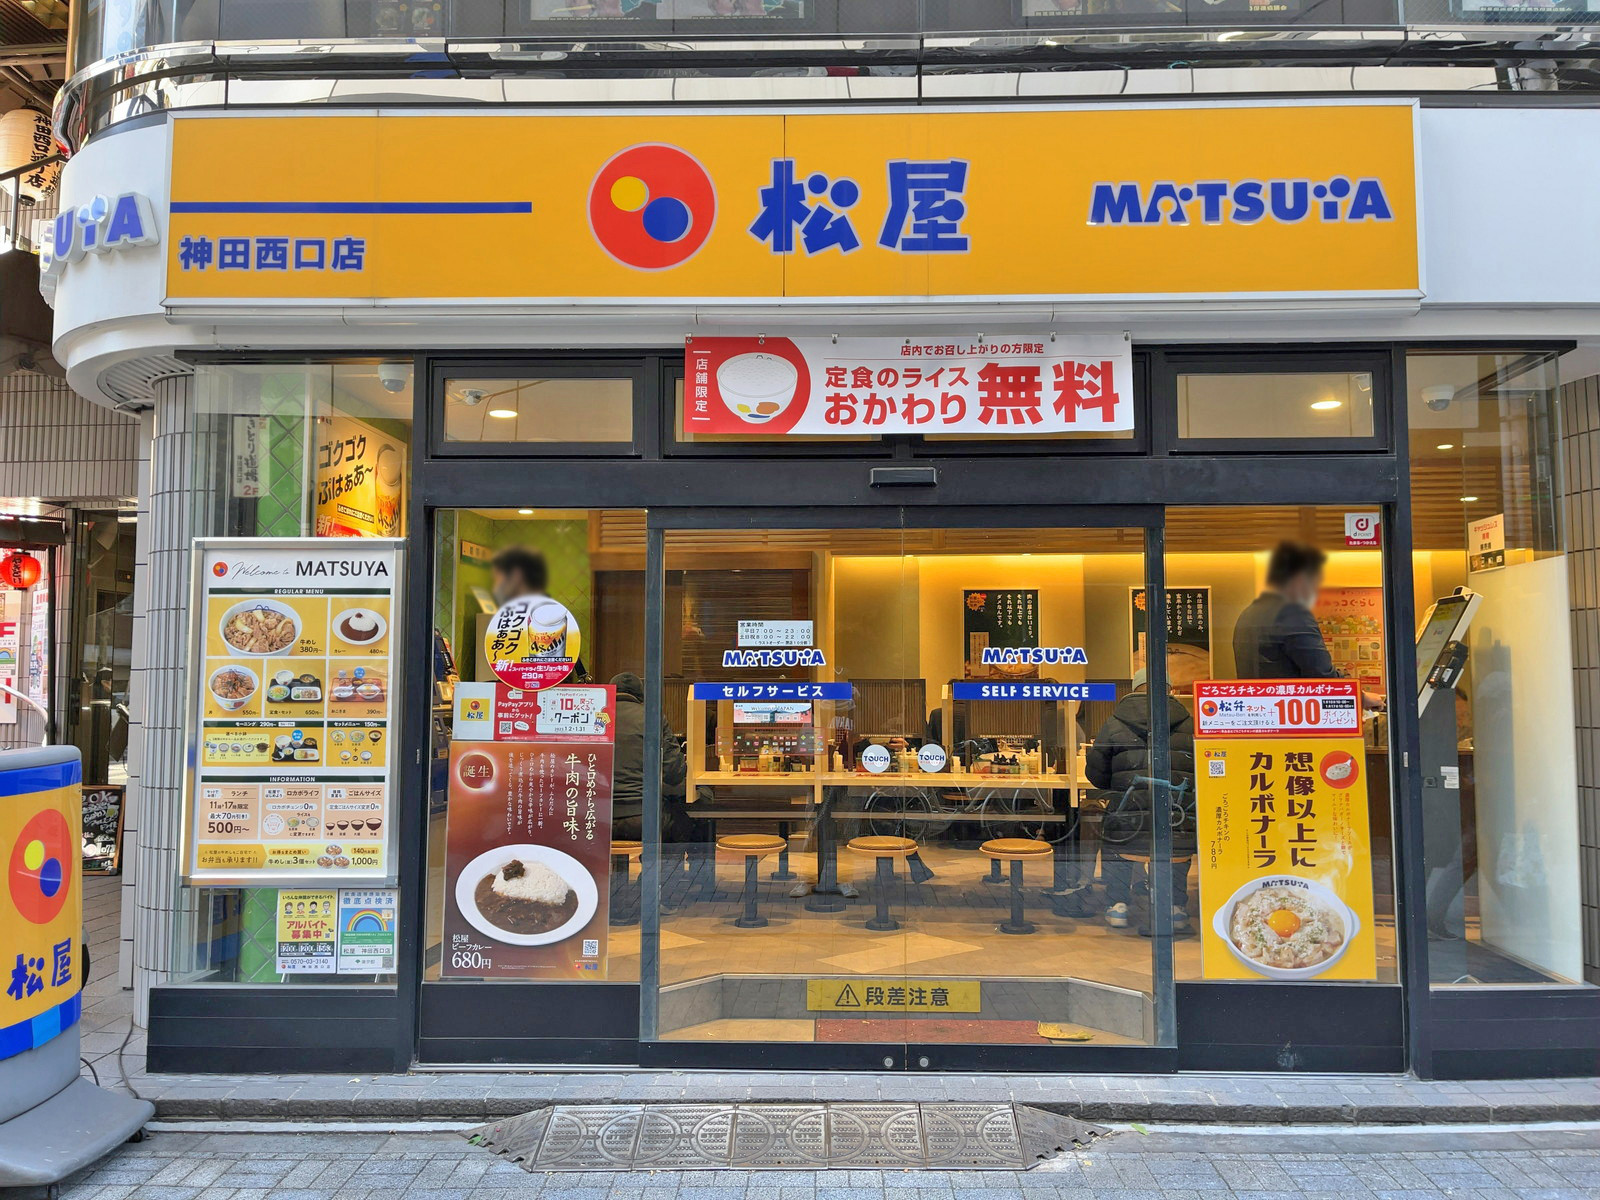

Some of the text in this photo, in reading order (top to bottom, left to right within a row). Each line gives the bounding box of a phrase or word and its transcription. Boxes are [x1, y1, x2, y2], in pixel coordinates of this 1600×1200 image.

[750, 158, 971, 255] 松屋
[1089, 177, 1393, 224] MATSUYA
[179, 235, 366, 272] 神田西口店
[900, 343, 1045, 355] 店内でお召し上がりの方限定
[694, 358, 709, 413] 店舗限定
[824, 366, 970, 389] 定食のライス
[977, 361, 1120, 424] 無料
[824, 392, 968, 425] おかわり
[319, 434, 367, 470] ゴクゴク
[232, 561, 280, 580] Welcome
[296, 560, 389, 577] MATSUYA
[722, 648, 827, 668] MATSUYA
[981, 647, 1089, 665] MATSUYA
[722, 685, 824, 697] セルフサービス
[981, 685, 1090, 698] SELF SERVICE
[1201, 685, 1353, 697] ごろごろチキンの濃厚カルボナーラ
[466, 711, 483, 720] 松屋
[1219, 700, 1245, 712] 松弁
[1274, 698, 1321, 725] 100
[554, 712, 589, 724] クーポン
[463, 764, 491, 778] 誕生
[563, 753, 582, 841] 牛肉の旨味。
[584, 753, 597, 841] ひと口めから広がる
[1222, 793, 1230, 842] ごろごろチキンの
[1250, 752, 1276, 869] カルボナーラ
[1285, 752, 1317, 868] 想像以上に
[1215, 806, 1223, 855] 濃厚カルボナーラ
[286, 920, 327, 930] アルバイト
[291, 930, 322, 939] 募集中
[452, 933, 469, 943] 松屋
[6, 938, 72, 1001] 松屋
[451, 951, 492, 970] 680円
[865, 986, 950, 1007] 段差注意
